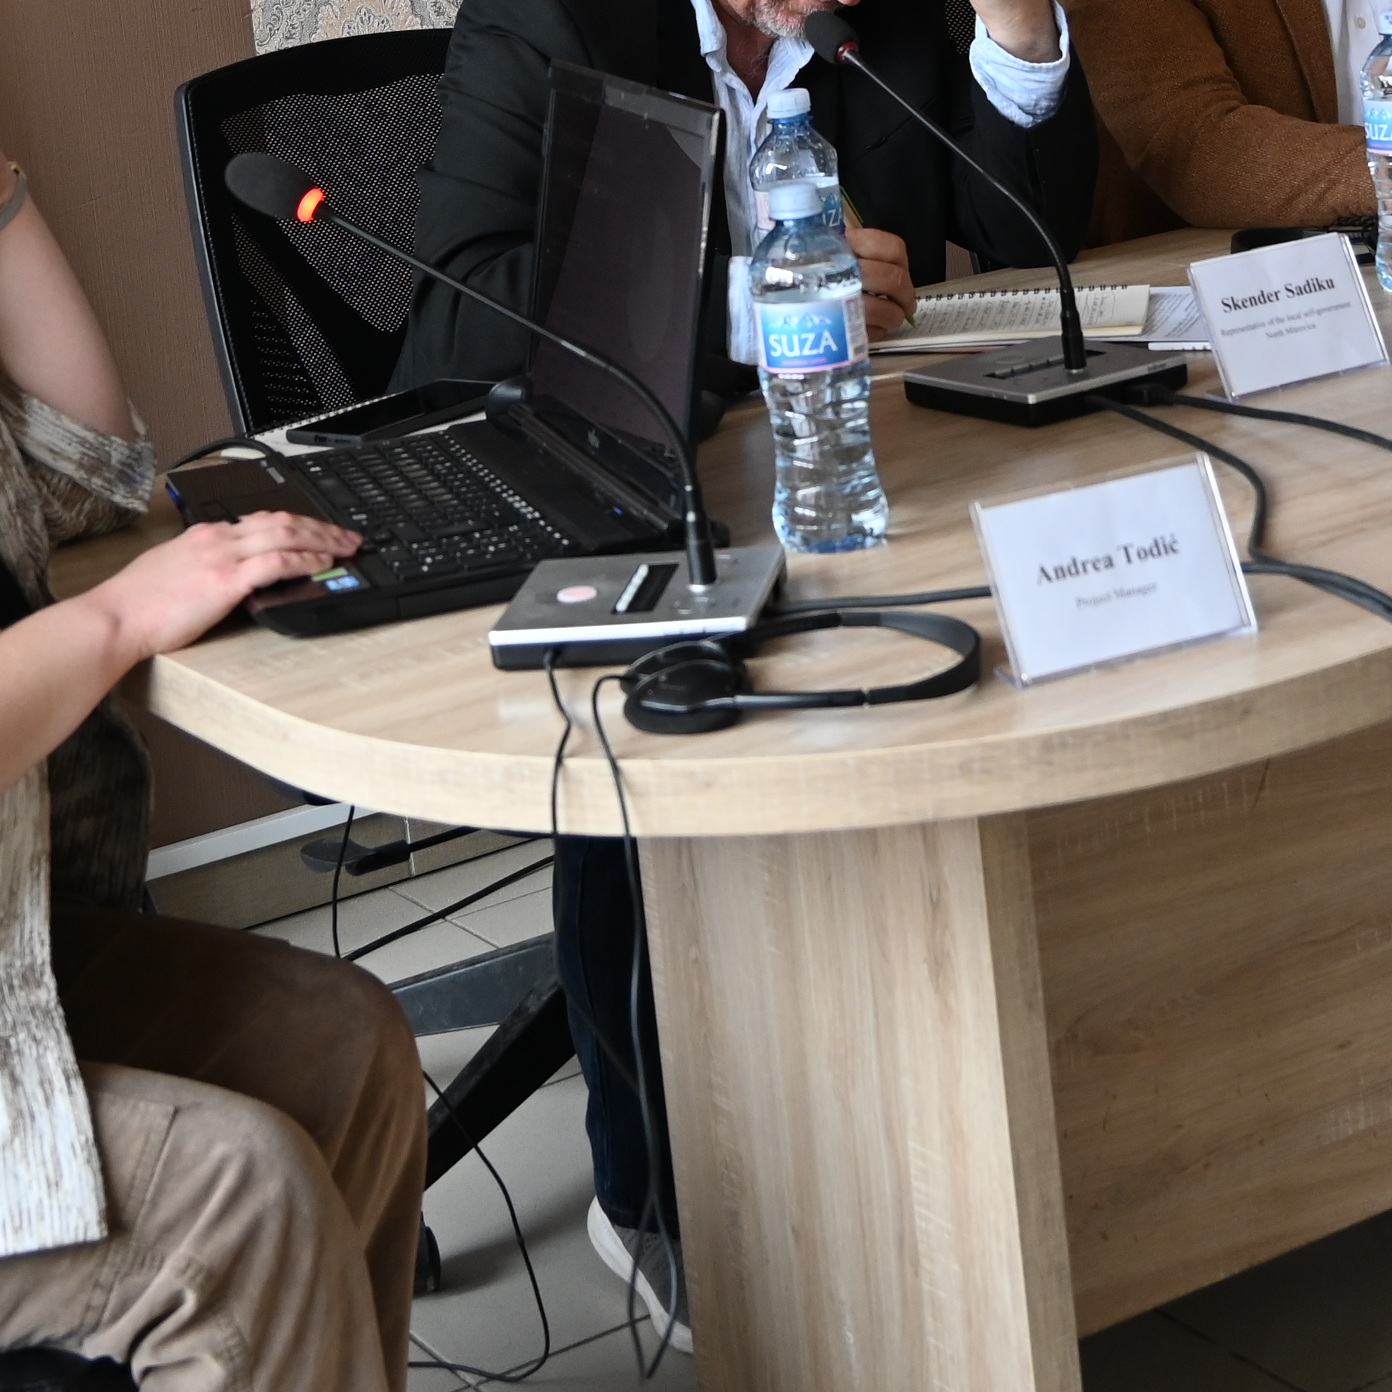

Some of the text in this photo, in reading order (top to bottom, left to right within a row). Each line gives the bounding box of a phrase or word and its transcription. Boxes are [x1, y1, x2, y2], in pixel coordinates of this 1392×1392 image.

[1221, 278, 1334, 313] Skender Sadiku
[769, 330, 838, 358] SUZA
[1036, 533, 1180, 585] Andrea Todić
